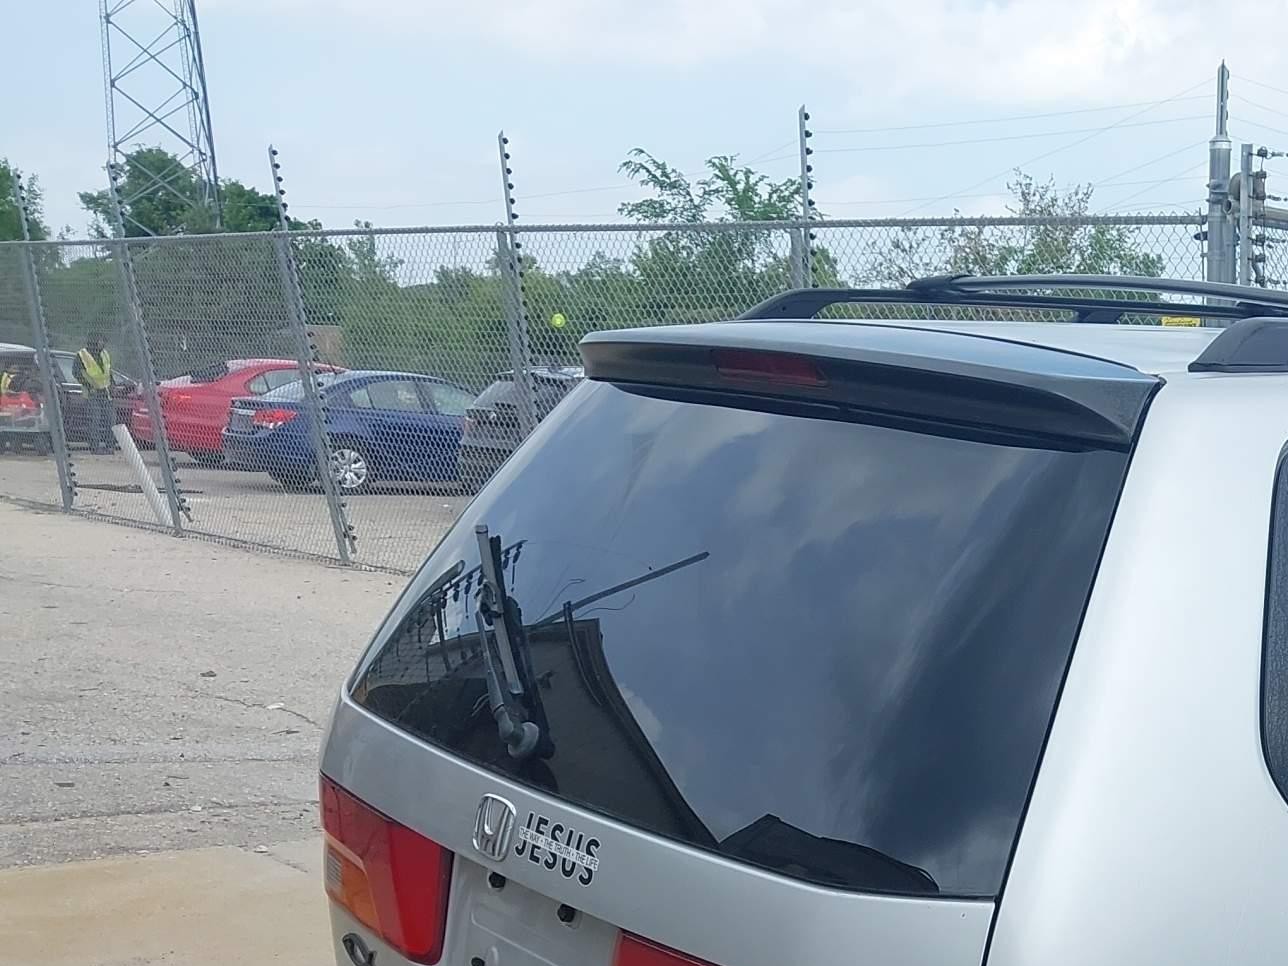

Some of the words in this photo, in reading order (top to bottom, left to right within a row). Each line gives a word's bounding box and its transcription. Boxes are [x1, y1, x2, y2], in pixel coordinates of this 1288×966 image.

[515, 812, 601, 886] JESUS
[554, 842, 572, 857] TRUTH
[585, 857, 598, 869] LIFE
